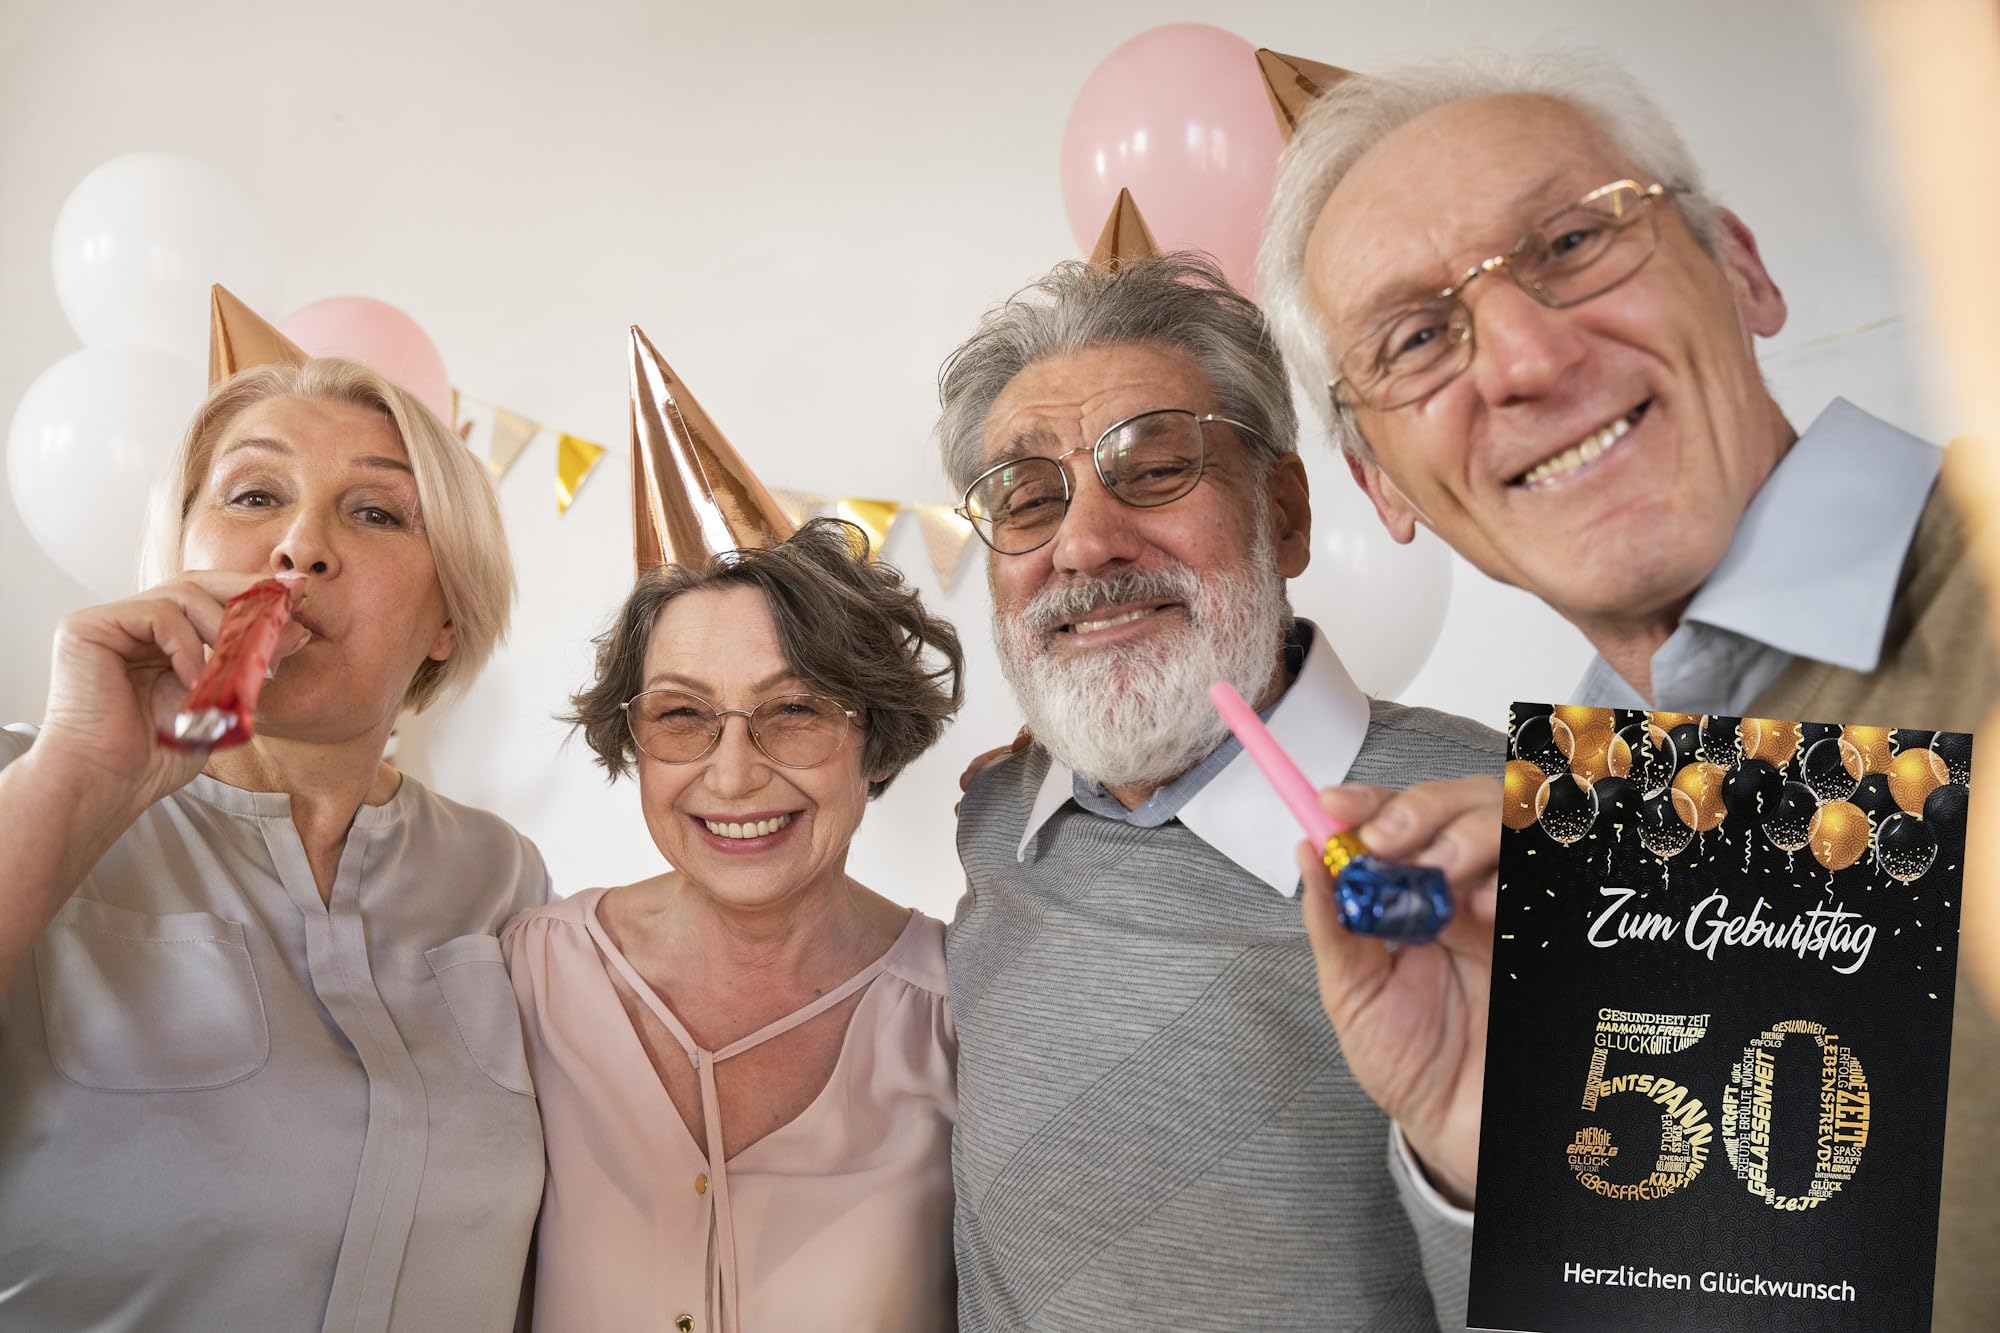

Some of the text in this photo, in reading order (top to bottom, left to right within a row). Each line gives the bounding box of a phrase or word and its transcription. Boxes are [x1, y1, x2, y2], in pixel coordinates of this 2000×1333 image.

[1587, 886, 1877, 974] Zum Geburtstag
[1598, 1008, 1711, 1027] GESUNDHEIT ZEIT
[1771, 1019, 1827, 1036] GESUNDHEIT
[1656, 1025, 1706, 1039] FREUDE
[1760, 1031, 1786, 1041] ENERGIE
[1594, 1031, 1651, 1055] GLÜCK
[1650, 1035, 1672, 1055] GUTE
[1837, 1046, 1851, 1089] ERFOLG
[1848, 1056, 1868, 1091] FREUDE
[1721, 1084, 1739, 1137] KRAFT
[1737, 1046, 1756, 1180] FREUDE ERFÜLLTE WÜNSCHE
[1833, 1088, 1871, 1148] ZEIT
[1600, 1073, 1714, 1181] ENTSPANNUNG
[1660, 1113, 1673, 1152] ERFOLG
[1747, 1048, 1776, 1197] GELASSENHEIT
[1575, 1126, 1612, 1147] ENERGIE
[1671, 1124, 1683, 1154] SPASS
[1566, 1143, 1619, 1157] ERFOLG
[1681, 1139, 1690, 1156] ZEIT
[1833, 1145, 1863, 1157] SPASS
[1568, 1154, 1610, 1167] GLÜCK
[1659, 1154, 1692, 1163] ENERGIE
[1832, 1156, 1862, 1166] KRAFT
[1831, 1164, 1857, 1174] ERFOLG
[1575, 1171, 1675, 1201] LEBENSFREUDE
[1648, 1171, 1690, 1189] KRAFT
[1810, 1178, 1843, 1192] GLÜCK
[1807, 1188, 1834, 1199] FREUDE
[1563, 1262, 1856, 1302] Herzlichen Glückwunsch
